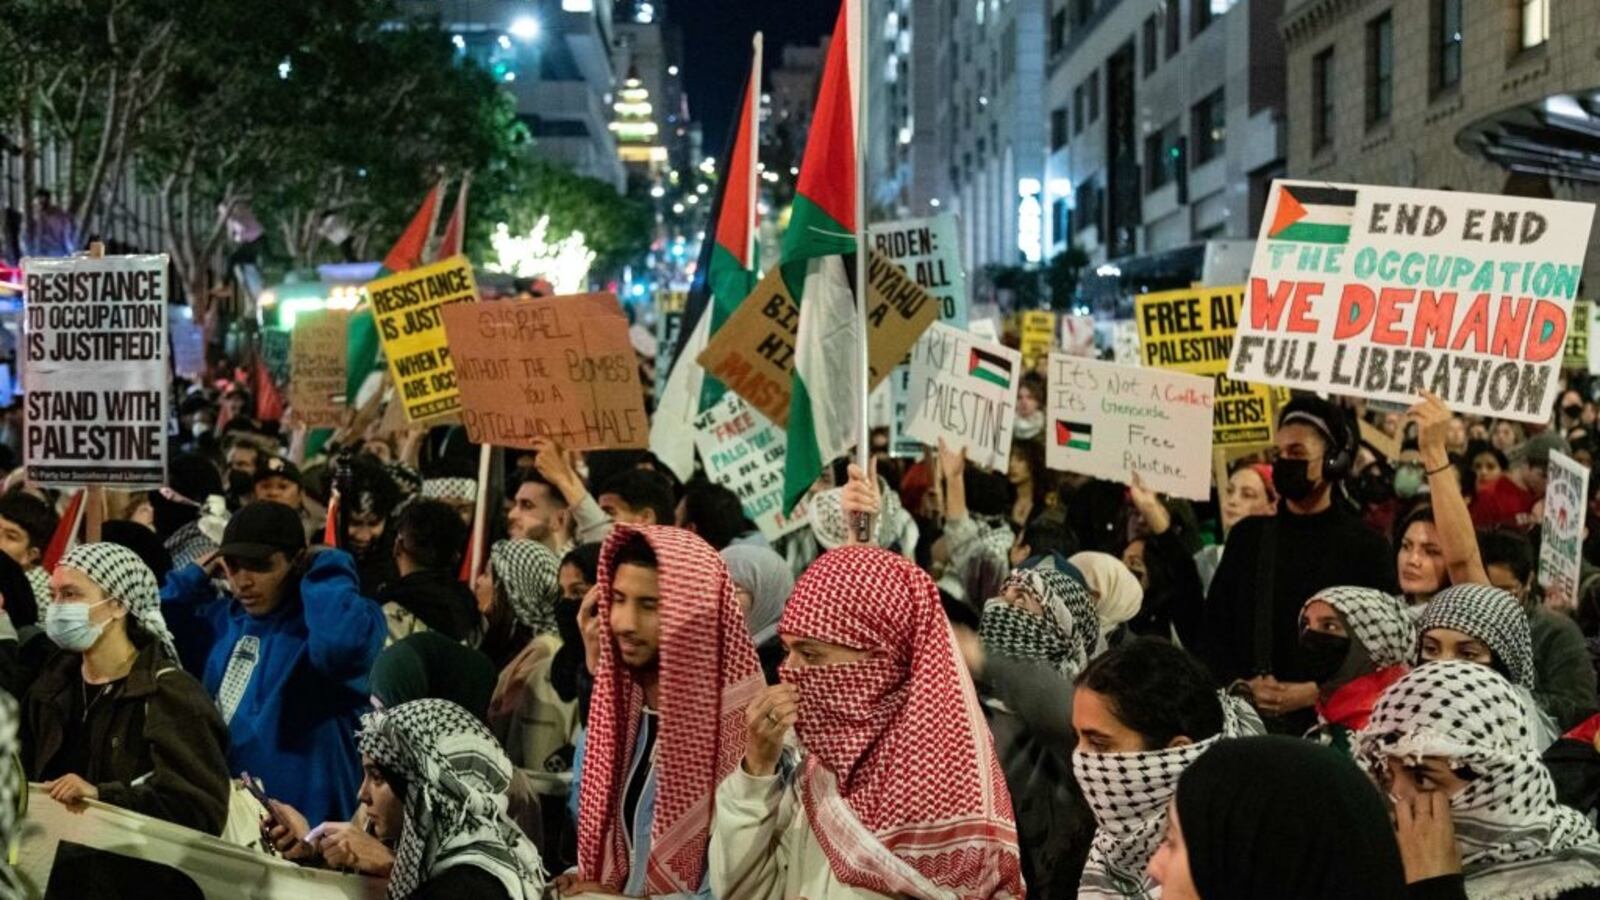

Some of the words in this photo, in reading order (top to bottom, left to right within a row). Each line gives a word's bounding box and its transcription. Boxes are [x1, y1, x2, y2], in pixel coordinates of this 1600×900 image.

[1368, 202, 1447, 237] END
[1462, 208, 1548, 245] END
[876, 227, 939, 259] BIDEN:
[27, 270, 161, 303] RESISTANCE
[916, 259, 951, 288] ALL
[1267, 243, 1346, 274] THE
[1353, 246, 1582, 300] OCCUPATION
[372, 267, 471, 314] RESISTANCE
[28, 307, 45, 328] TO
[51, 304, 161, 329] OCCUPATION
[380, 316, 399, 341] IS
[868, 302, 889, 328] A
[1142, 298, 1203, 336] FREE
[1210, 293, 1245, 330] AL
[1250, 277, 1325, 334] WE
[1333, 283, 1568, 363] DEMAND
[28, 333, 44, 361] IS
[50, 332, 161, 362] JUSTIFIED!
[912, 328, 968, 378] FREE
[394, 350, 438, 378] WHEN
[457, 353, 511, 381] WITHOUT
[518, 357, 550, 379] THE
[1233, 335, 1319, 382] FULL
[1330, 343, 1551, 415] LIBERATION
[403, 378, 431, 400] ARE
[520, 383, 546, 405] YOU
[552, 384, 565, 402] A
[1107, 373, 1142, 396] Not
[1151, 384, 1161, 400] A
[1214, 372, 1255, 397] CAL
[28, 391, 97, 422] STAND
[103, 391, 160, 422] WITH
[693, 411, 716, 431] WE
[924, 377, 1013, 456] PALESTINE
[466, 408, 516, 443] BITCH
[560, 417, 577, 443] A
[581, 408, 639, 443] HALF
[1128, 423, 1175, 449] Free
[28, 425, 161, 461] PALESTINE
[736, 482, 755, 498] AN
